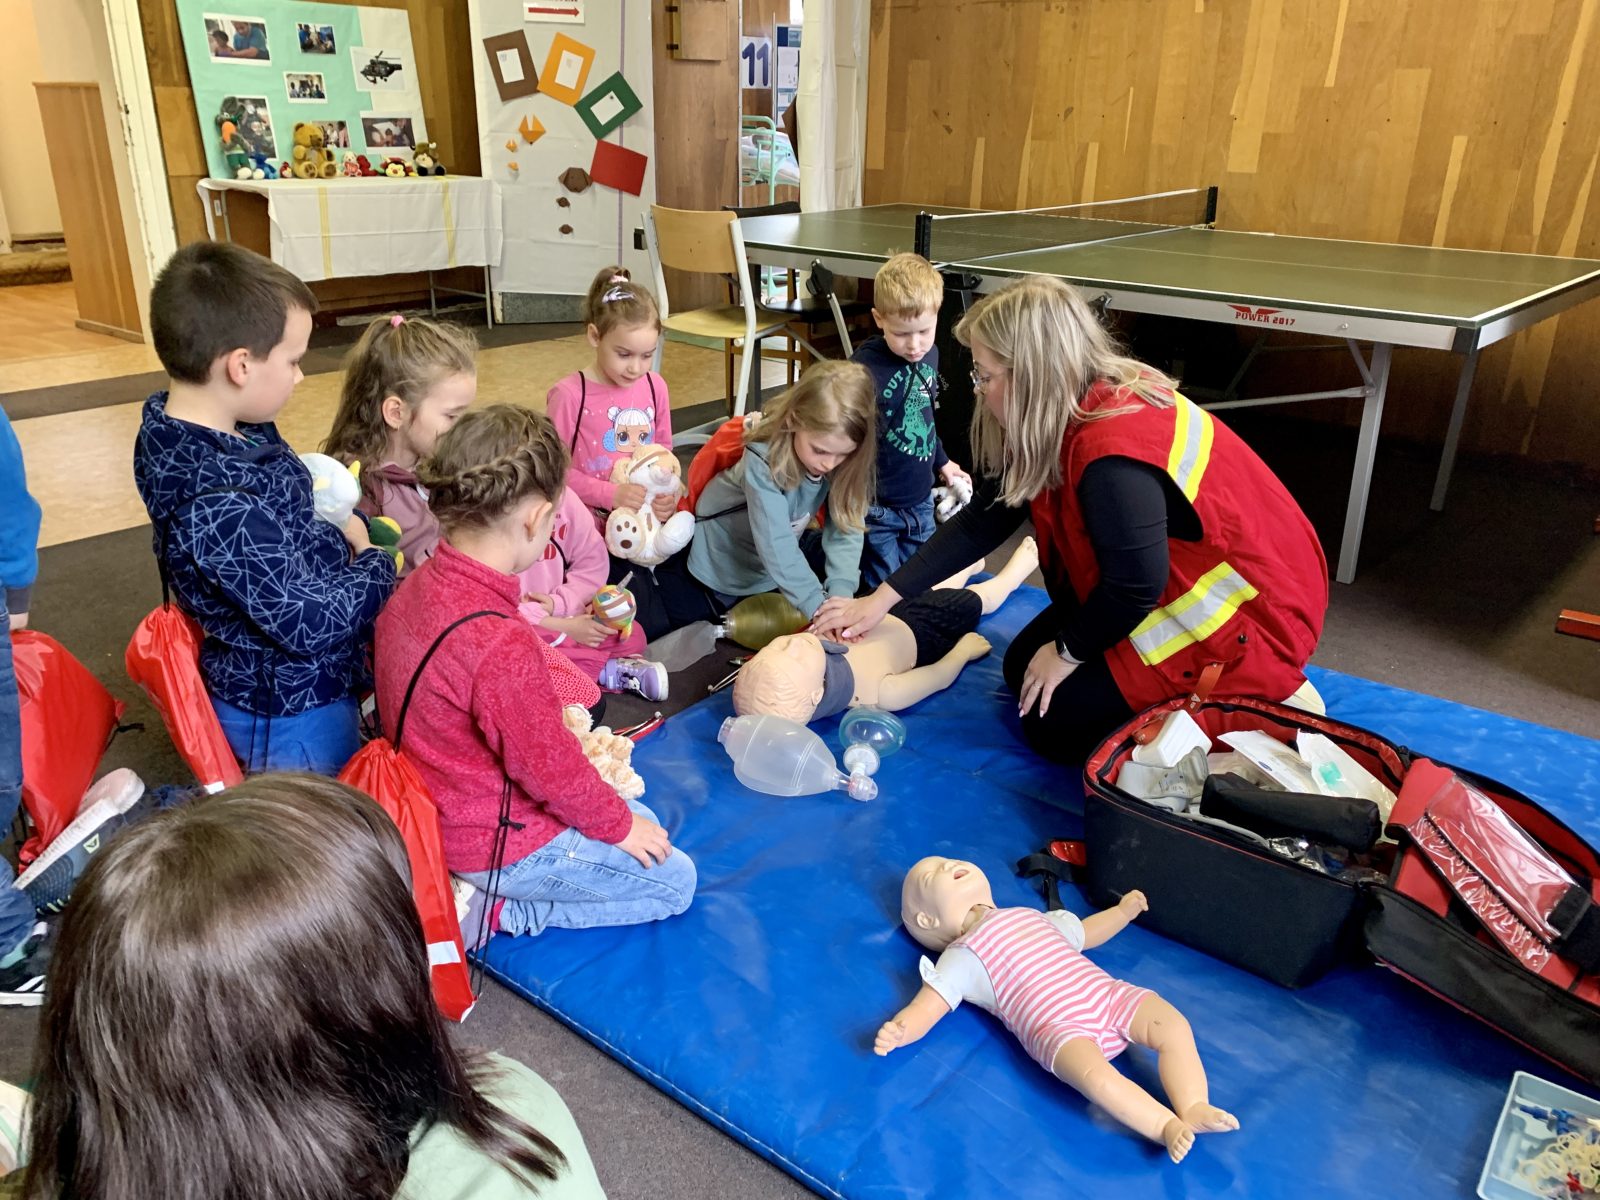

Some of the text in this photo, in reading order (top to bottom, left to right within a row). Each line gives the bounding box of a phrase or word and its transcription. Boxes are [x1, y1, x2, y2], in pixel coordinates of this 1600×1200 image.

[742, 42, 768, 87] 11
[1235, 311, 1296, 326] POWER 2017
[883, 370, 904, 399] OUT
